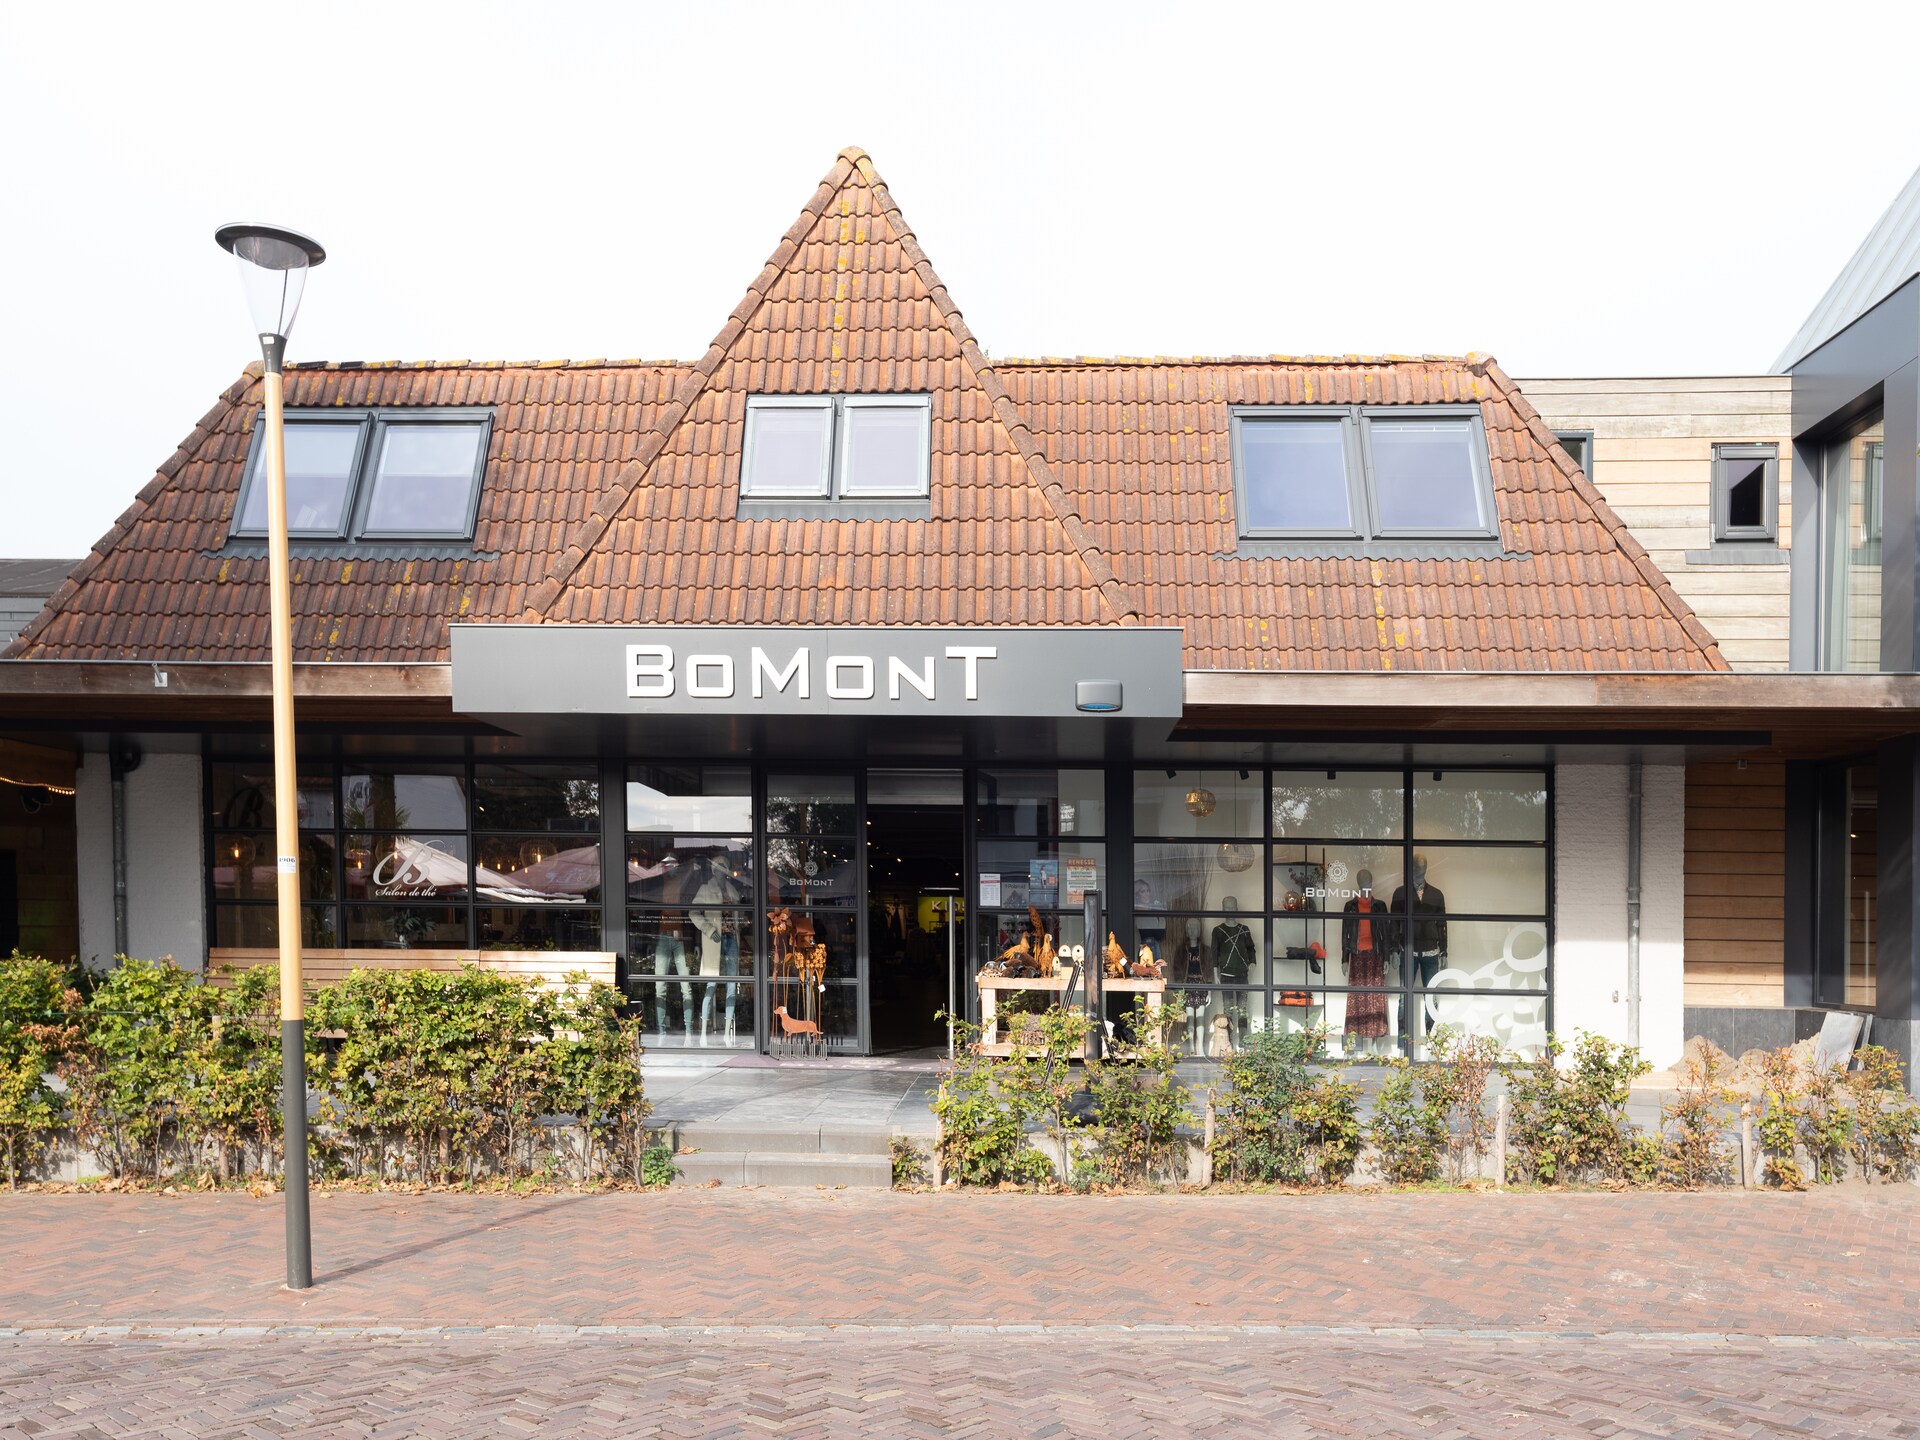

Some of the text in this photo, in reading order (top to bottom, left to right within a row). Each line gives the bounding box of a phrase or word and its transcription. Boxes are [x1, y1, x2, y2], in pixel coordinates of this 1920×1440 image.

[375, 884, 437, 897] Salon de thé
[931, 900, 965, 912] KID
